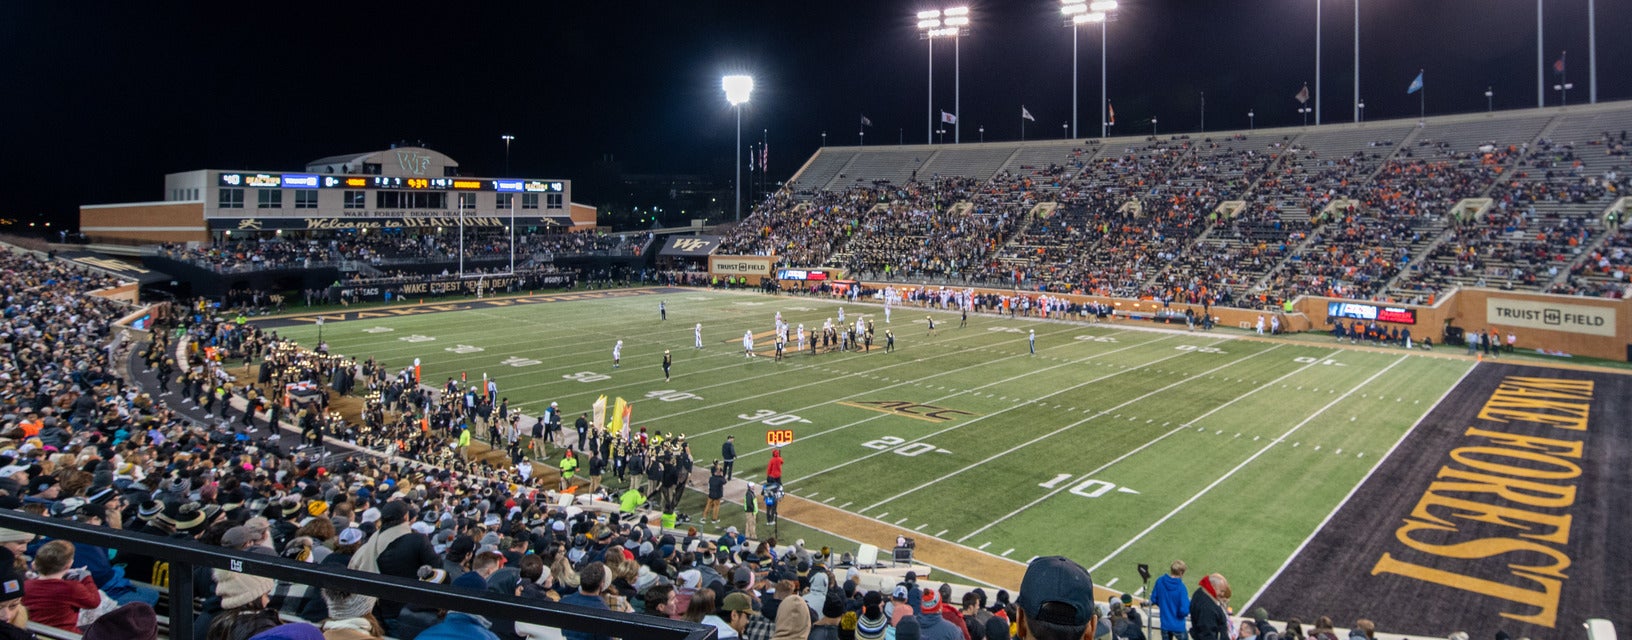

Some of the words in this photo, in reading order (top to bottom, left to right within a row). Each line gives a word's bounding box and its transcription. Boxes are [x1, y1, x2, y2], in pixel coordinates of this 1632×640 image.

[397, 152, 431, 175] WF
[408, 178, 428, 189] 9:39
[304, 218, 380, 228] Welcome
[385, 219, 402, 228] to
[402, 216, 503, 228] DEACTOWN
[673, 238, 710, 252] WF
[403, 282, 428, 294] WAKE
[1496, 307, 1540, 320] TRUIST
[1565, 313, 1605, 326] FIELD
[562, 371, 612, 383] 50
[645, 389, 695, 402] 40
[1477, 376, 1594, 431] WAKE
[738, 409, 801, 426] 30
[848, 401, 980, 421] ACC
[767, 430, 793, 444] 0:09
[861, 435, 936, 457] 20
[1038, 473, 1116, 498] 10
[1371, 426, 1583, 628] FOREST
